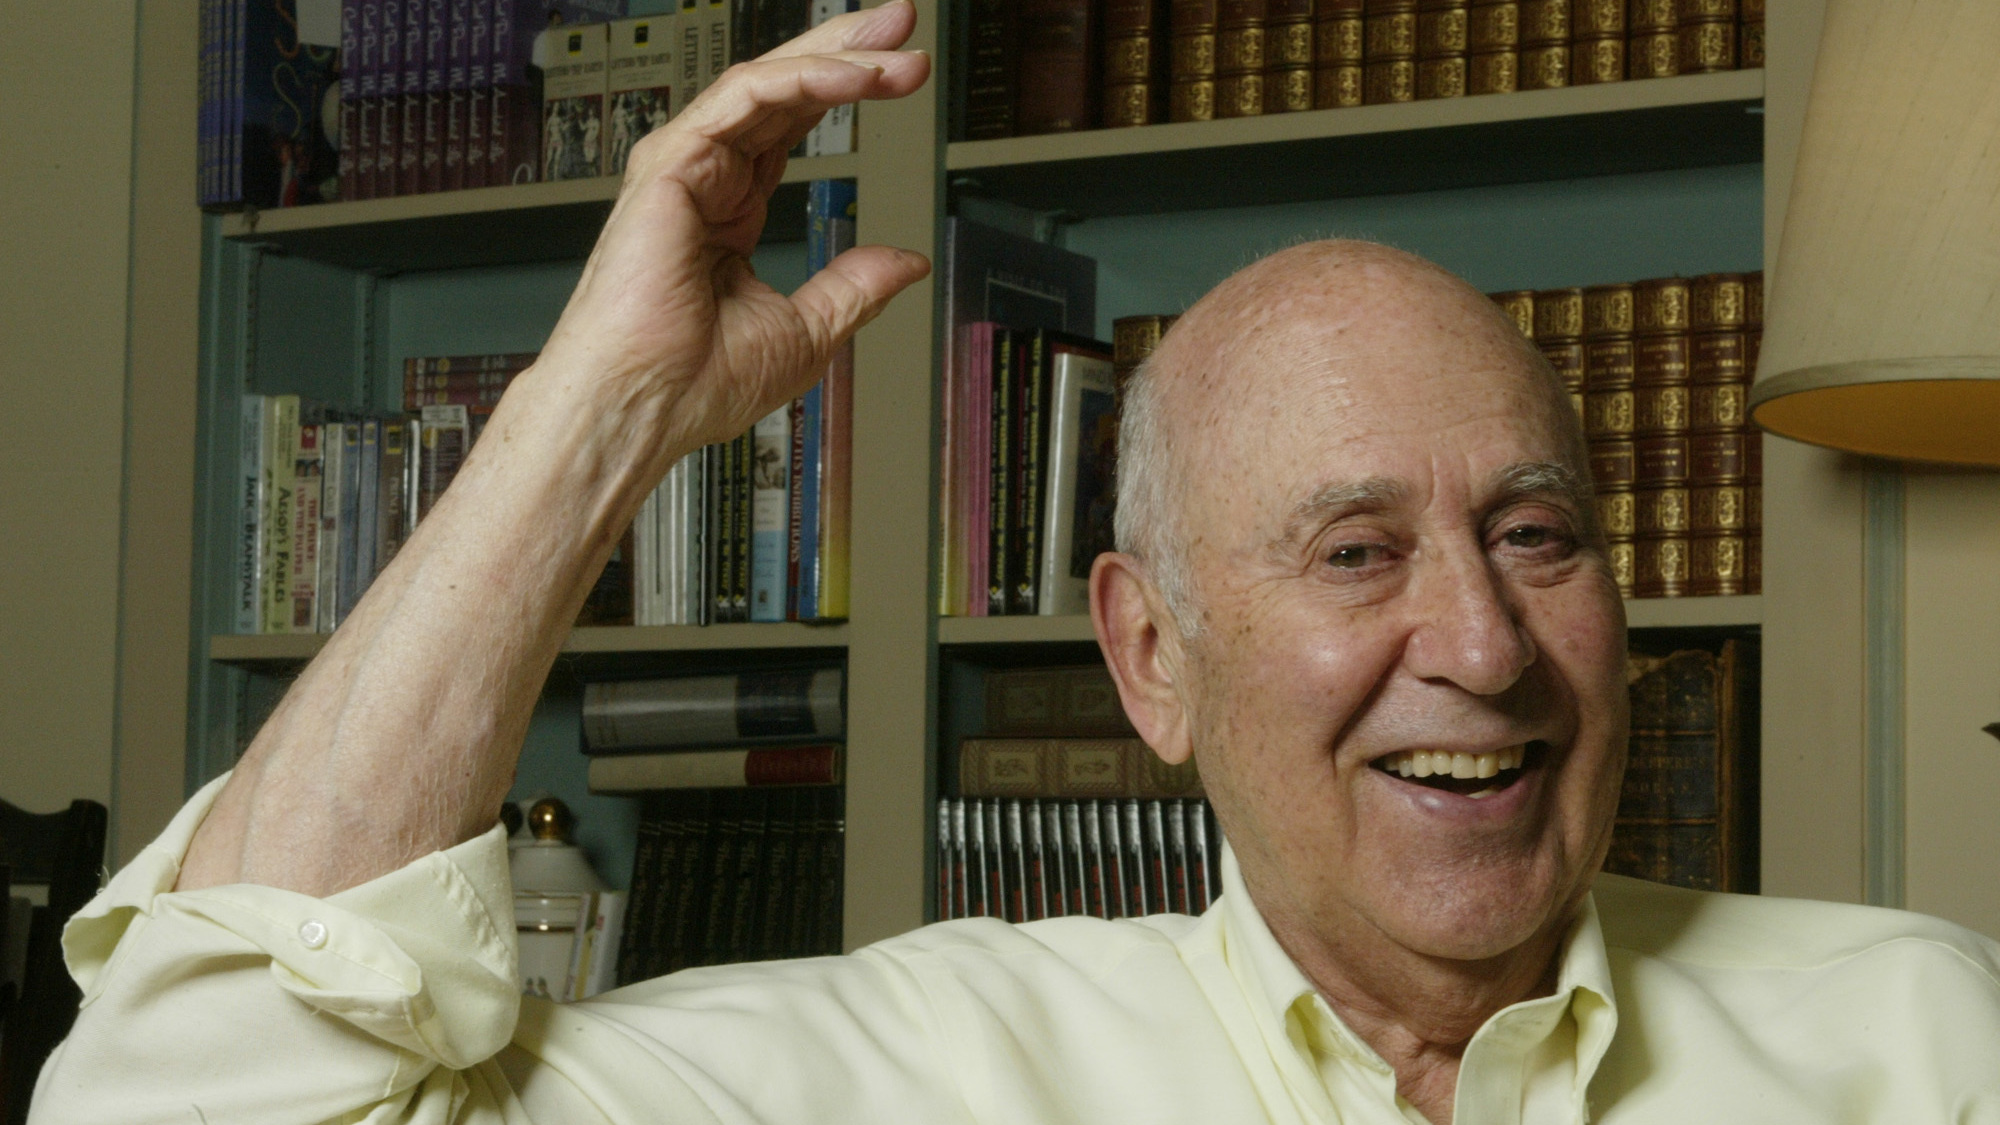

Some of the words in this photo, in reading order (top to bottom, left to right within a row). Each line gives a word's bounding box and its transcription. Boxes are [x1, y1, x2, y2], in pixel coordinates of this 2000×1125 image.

[685, 27, 698, 79] LETTERS
[711, 22, 725, 75] LETTERS
[793, 414, 804, 444] AND
[792, 449, 803, 469] ITS
[790, 475, 803, 563] INHIBITIONS
[275, 552, 289, 603] FABLES
